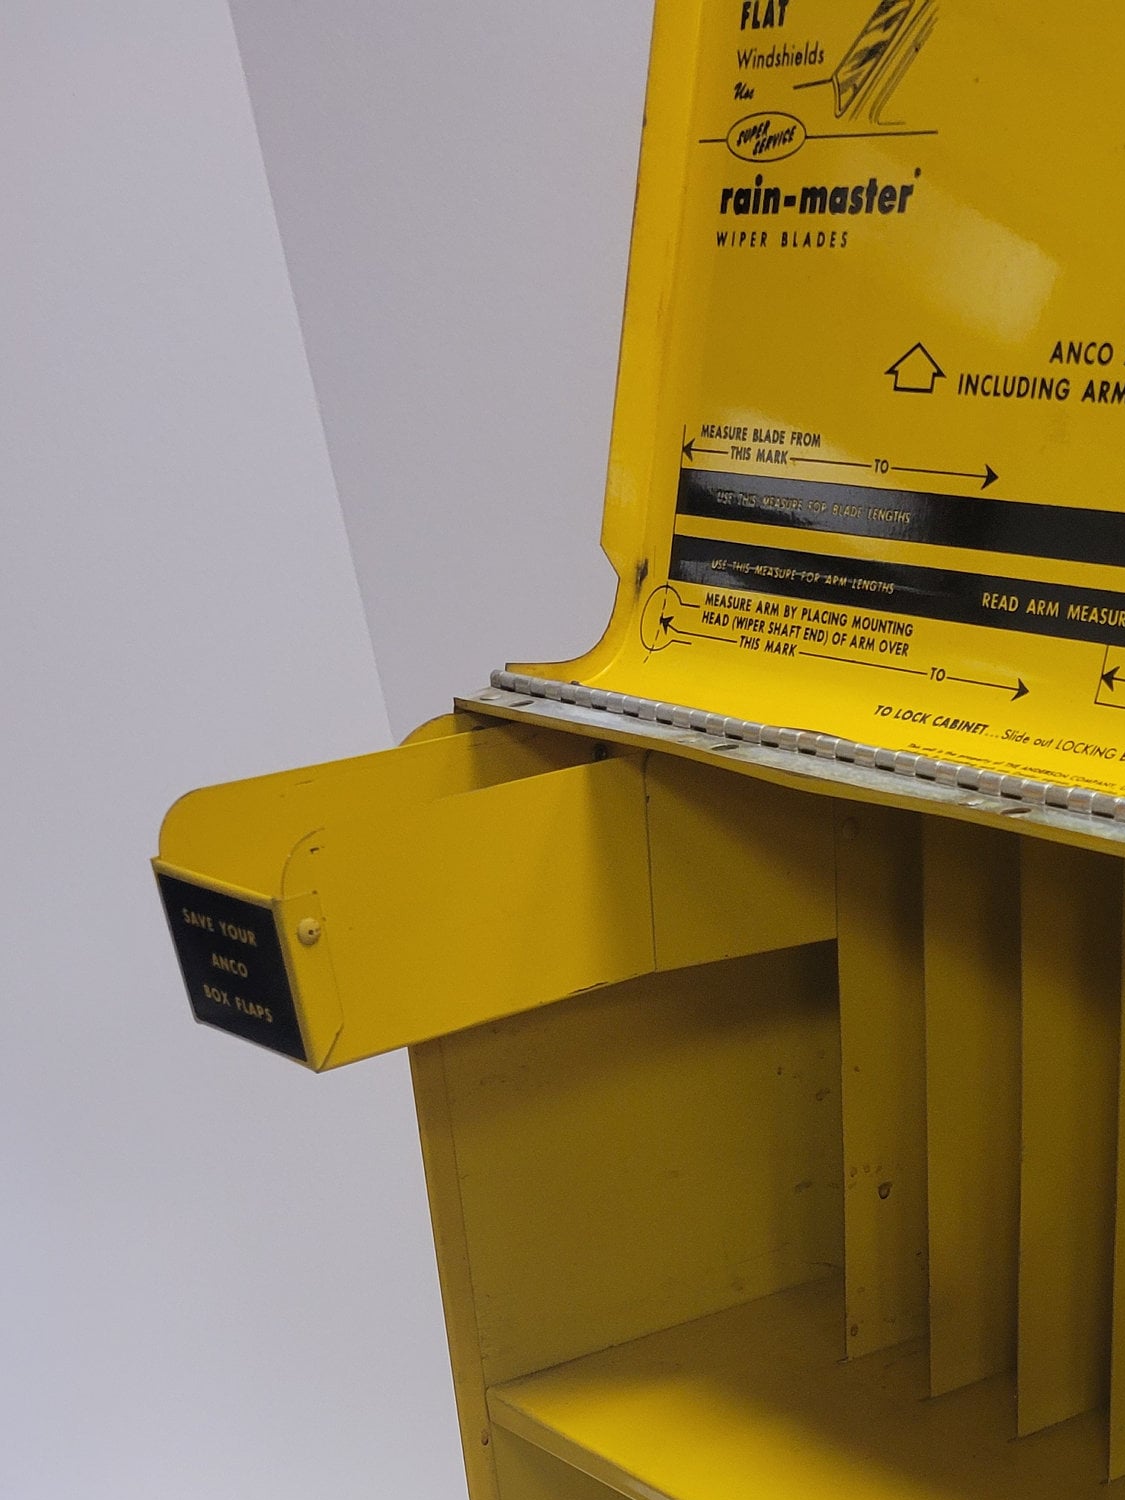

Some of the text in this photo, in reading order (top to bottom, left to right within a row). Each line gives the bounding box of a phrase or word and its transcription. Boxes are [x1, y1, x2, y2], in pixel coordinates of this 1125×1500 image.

[740, 0, 789, 30] FLAT
[737, 41, 824, 69] Windshields
[736, 120, 770, 147] SUPER
[752, 125, 797, 156] SERVICE
[716, 231, 848, 248] WIPER BLADES
[1050, 340, 1113, 368] ANCO
[957, 374, 1071, 402] INCLUDING
[700, 424, 822, 448] MEASURE BLADE FROM
[730, 445, 889, 474] THIS MARK TO
[711, 558, 895, 595] USE THIS MEASURE FOR ARM LENGTHS
[705, 592, 913, 637] MEASURE ARM BY PLACING MOUNTING
[982, 591, 1019, 612] READ
[1025, 598, 1059, 618] ARM
[702, 611, 910, 656] HEAD (WIPER SHAFT END) OF ARM OVER
[739, 635, 946, 682] THIS MARK TO
[874, 704, 892, 716] TO
[894, 709, 931, 725] LOCK
[1002, 729, 1030, 744] Slide
[1033, 737, 1054, 748] out
[1055, 739, 1117, 760] LOCKING
[182, 908, 257, 947] SAVE YOUR
[211, 953, 248, 978] ANCO
[203, 984, 273, 1023] BOX FLAPS
